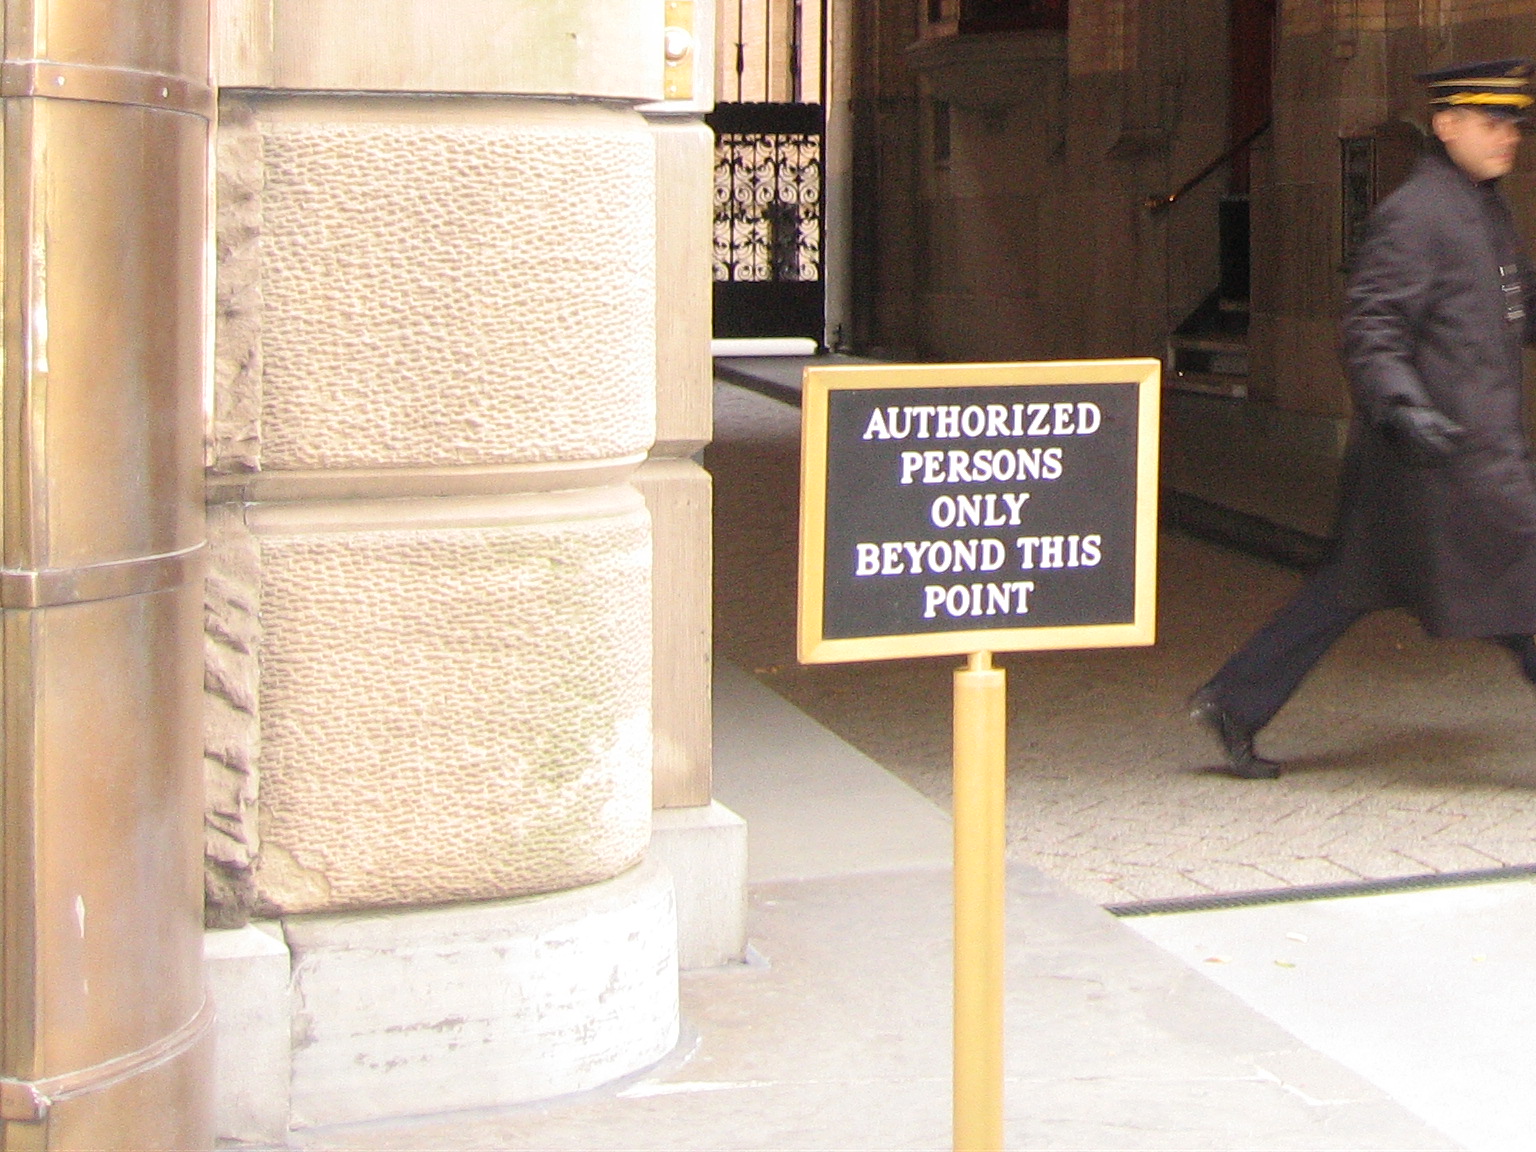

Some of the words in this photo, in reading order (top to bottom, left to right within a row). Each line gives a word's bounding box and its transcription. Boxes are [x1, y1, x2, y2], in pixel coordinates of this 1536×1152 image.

[862, 402, 1101, 440] AUTHORIZED
[900, 447, 1063, 484] PERSONS
[930, 493, 1029, 528] ONLY
[855, 539, 1006, 576] BEYOND
[1016, 534, 1102, 570] THIS
[923, 581, 1034, 618] POINT
